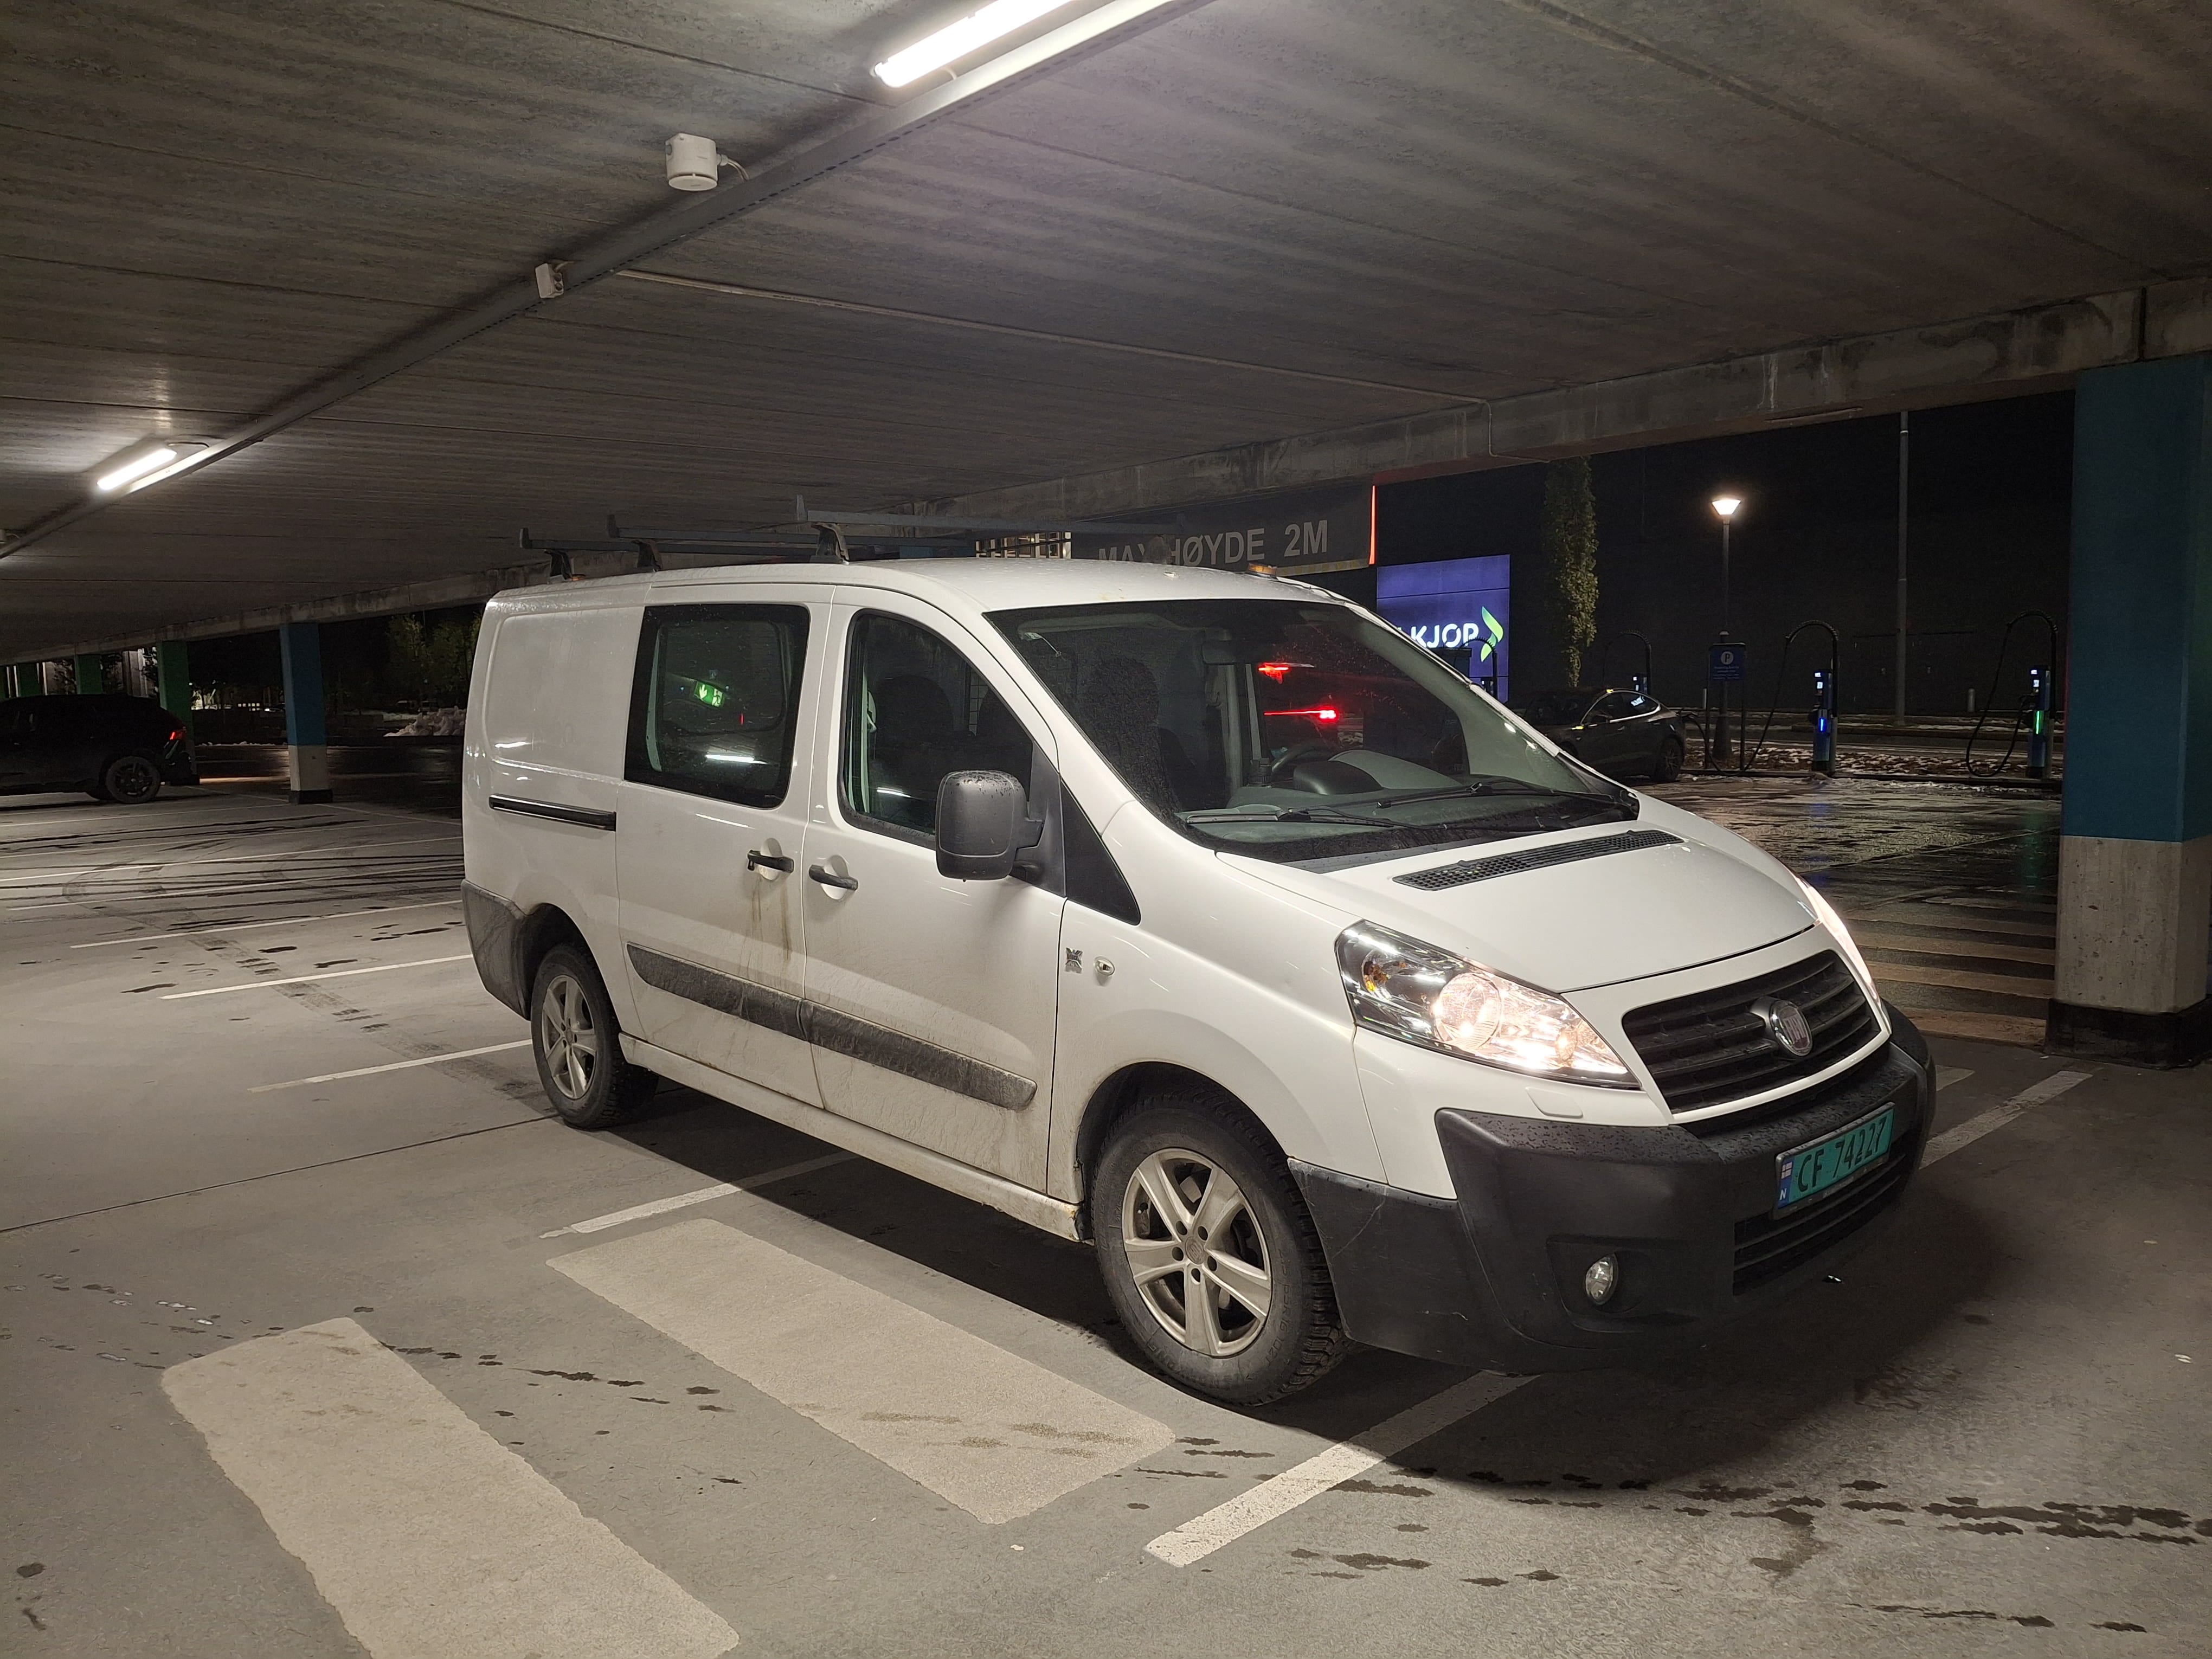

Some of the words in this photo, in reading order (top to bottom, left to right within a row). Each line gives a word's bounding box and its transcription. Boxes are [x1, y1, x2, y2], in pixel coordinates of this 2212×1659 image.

[1171, 528, 1265, 567] HØYDE
[1284, 520, 1328, 557] 2M
[1798, 1148, 1824, 1192] CF
[1832, 1116, 1887, 1178] 74227
[1779, 1188, 1787, 1201] N
